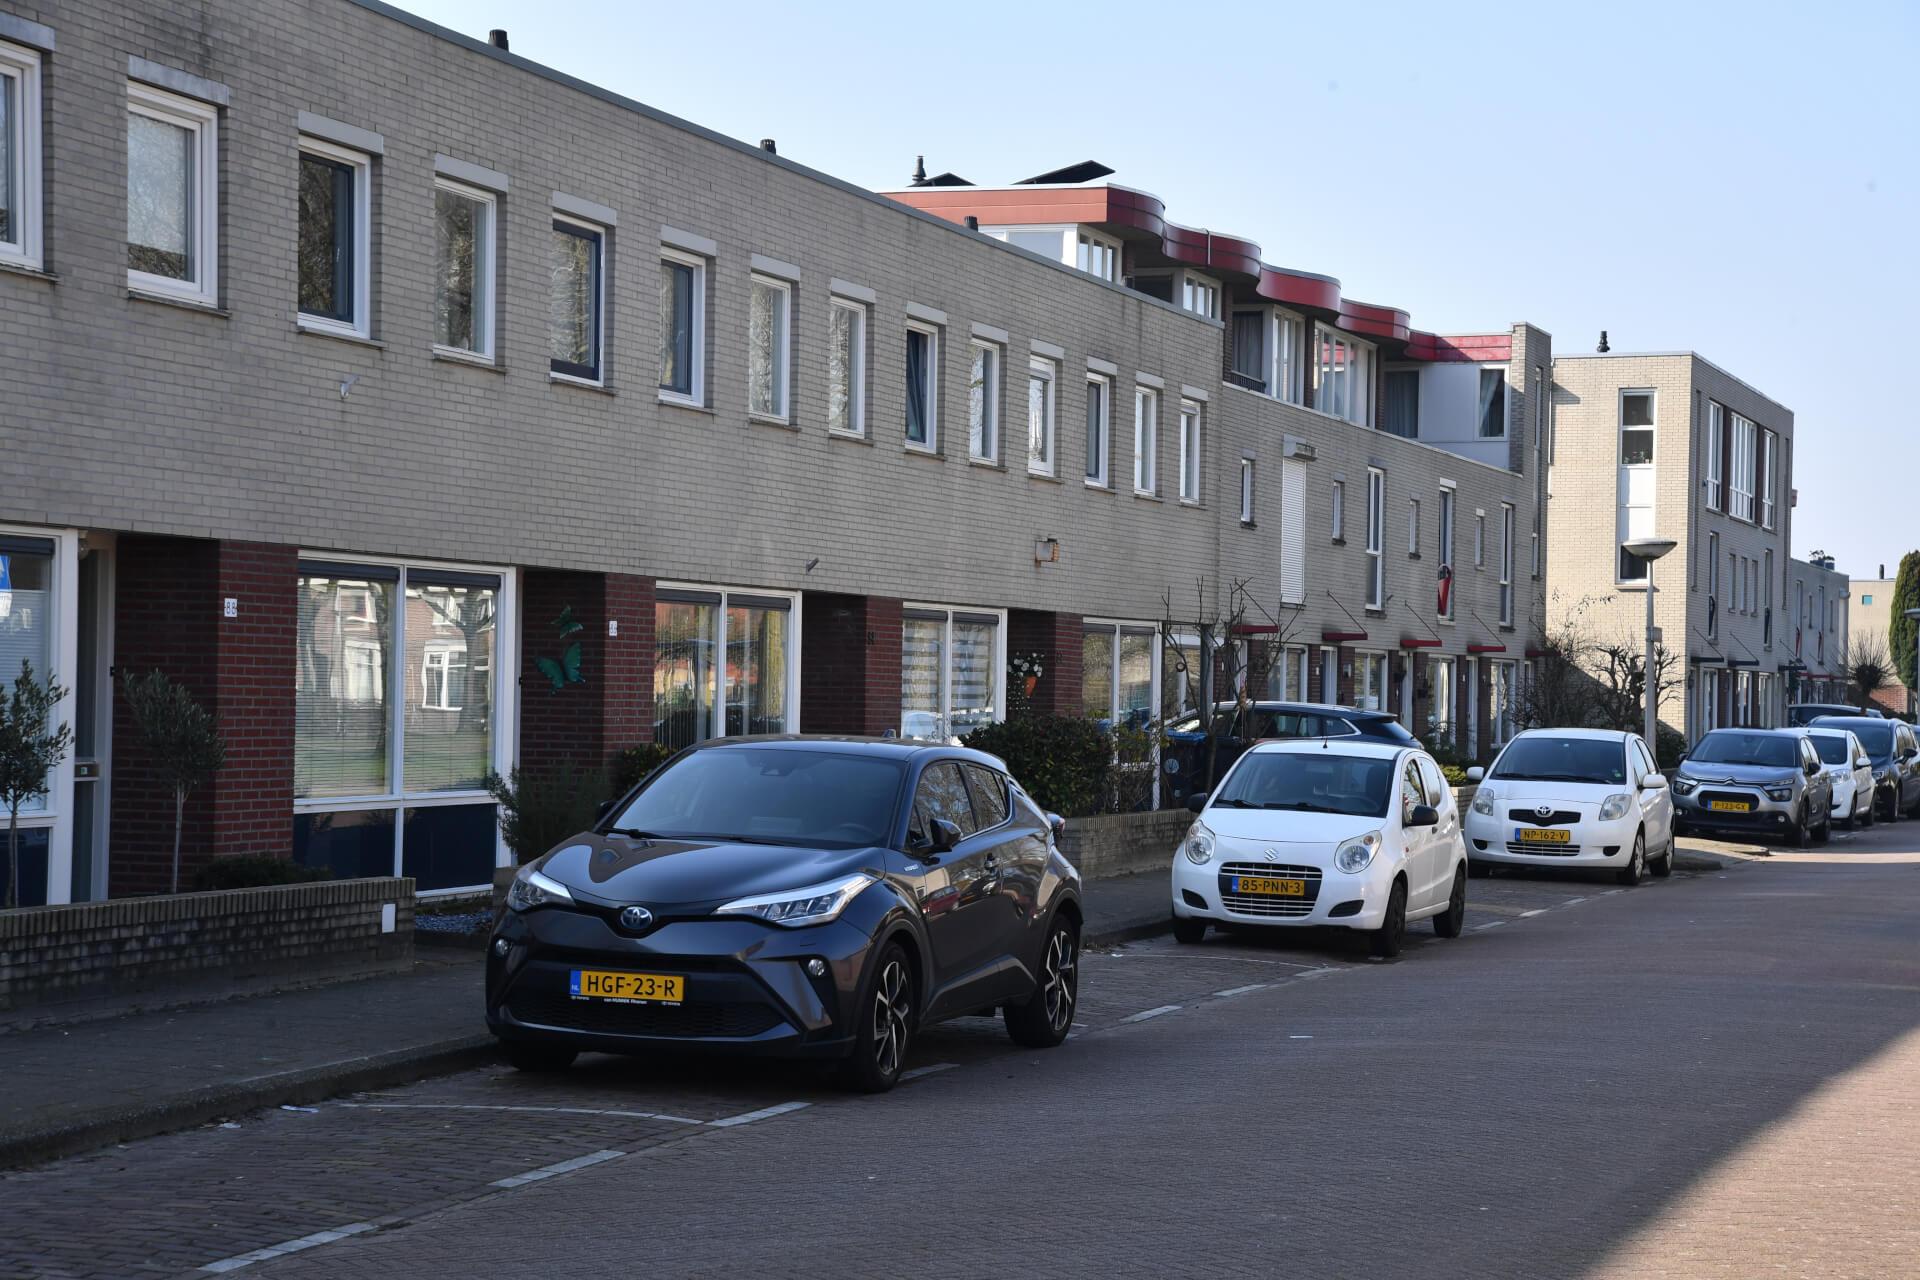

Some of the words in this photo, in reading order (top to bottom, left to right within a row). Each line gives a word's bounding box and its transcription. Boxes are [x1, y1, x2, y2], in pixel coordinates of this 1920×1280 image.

[1524, 831, 1565, 840] NP-162-V
[1241, 880, 1301, 894] 85-PNN-3
[587, 975, 675, 997] HGF-23-R
